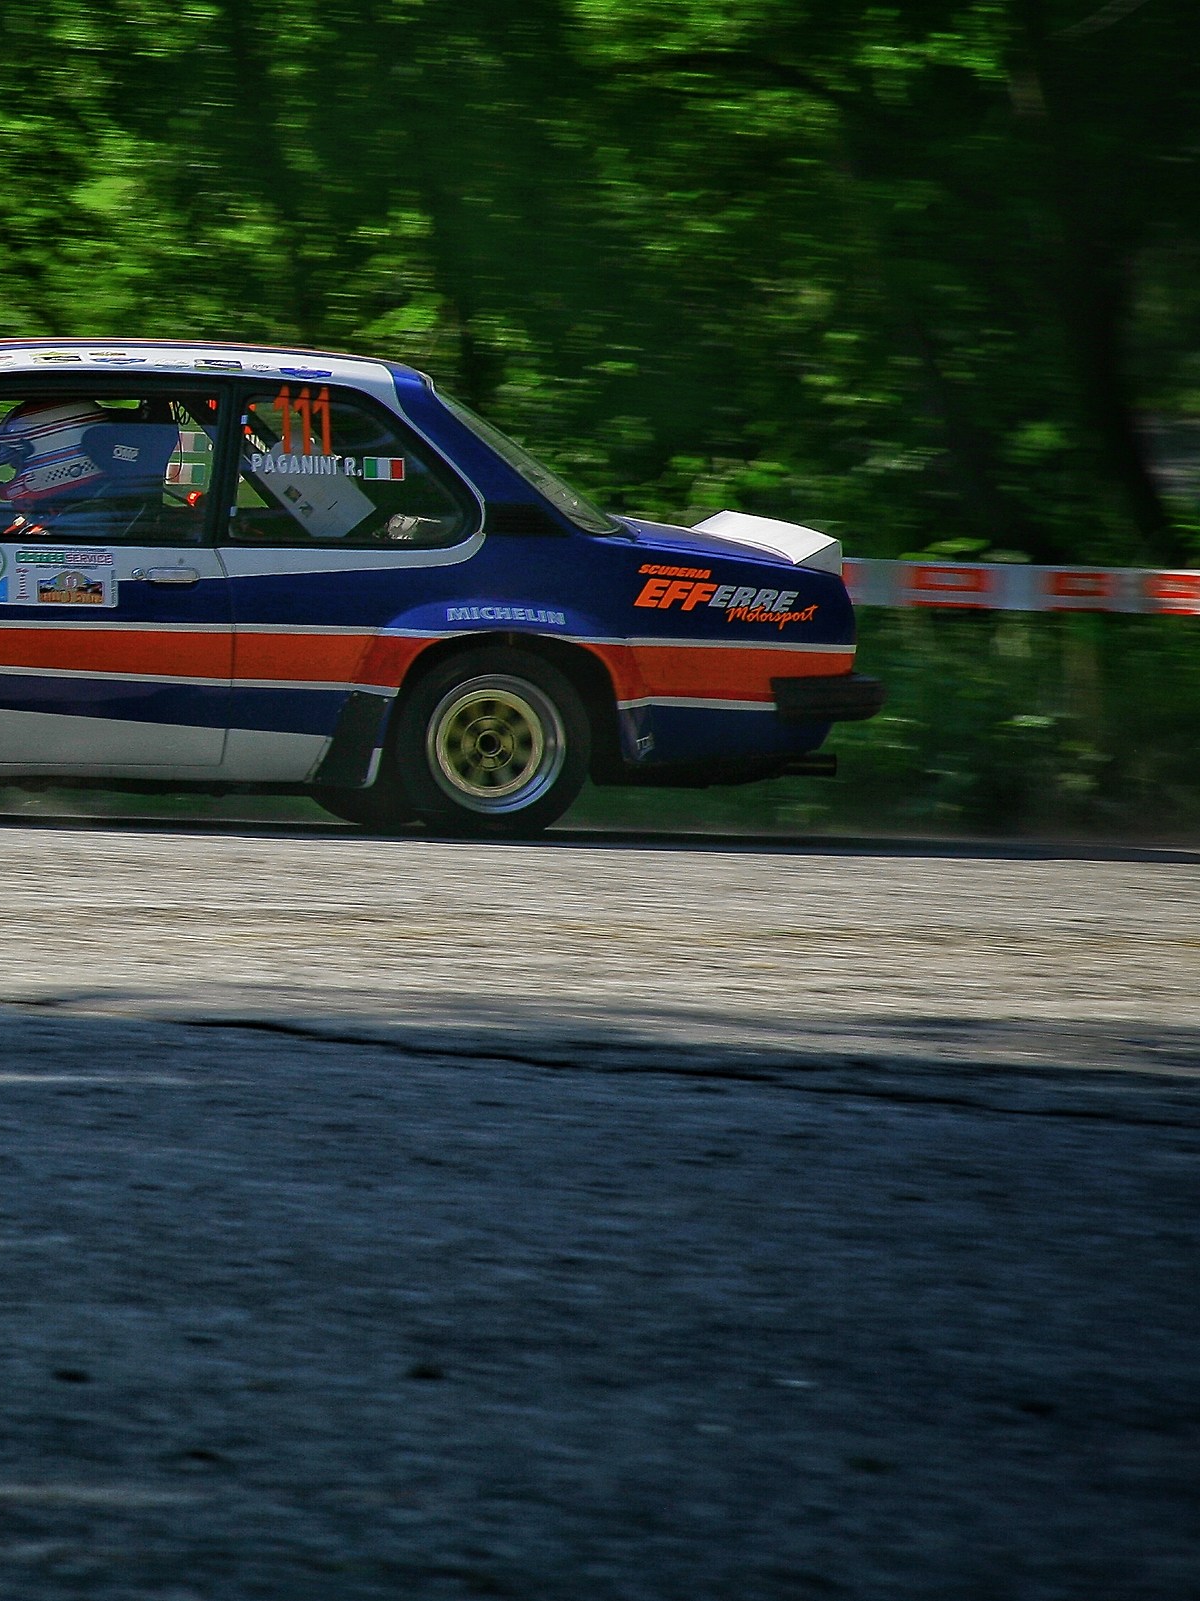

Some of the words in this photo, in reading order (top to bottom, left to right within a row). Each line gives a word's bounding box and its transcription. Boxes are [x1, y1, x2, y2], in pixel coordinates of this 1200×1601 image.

[273, 385, 331, 456] 111
[112, 445, 139, 461] OMP
[251, 453, 338, 475] PAGANINI
[344, 457, 363, 477] R.
[65, 553, 113, 566] SERVICE
[638, 564, 711, 579] SCUDERIA
[633, 577, 799, 613] EFFERRE
[446, 606, 566, 625] MICHELIN
[725, 603, 819, 630] Motorsport
